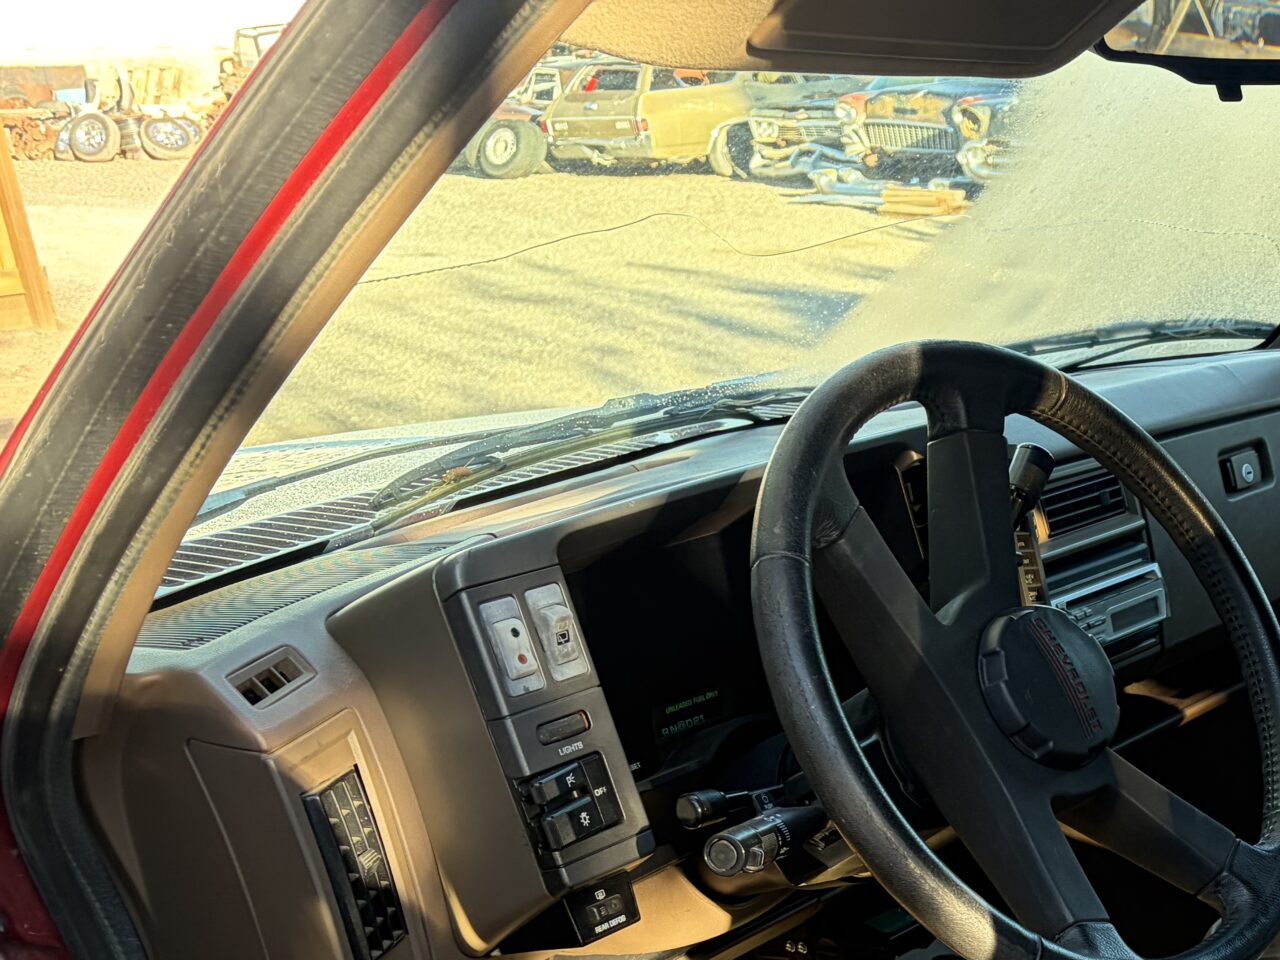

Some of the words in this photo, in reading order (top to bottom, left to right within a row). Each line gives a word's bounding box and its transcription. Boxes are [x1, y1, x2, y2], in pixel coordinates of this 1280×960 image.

[1032, 617, 1102, 732] CHEVROLET
[558, 741, 584, 756] LIGHTS
[594, 786, 608, 797] OFF
[594, 922, 610, 934] REAR
[609, 914, 627, 927] DEFOG
